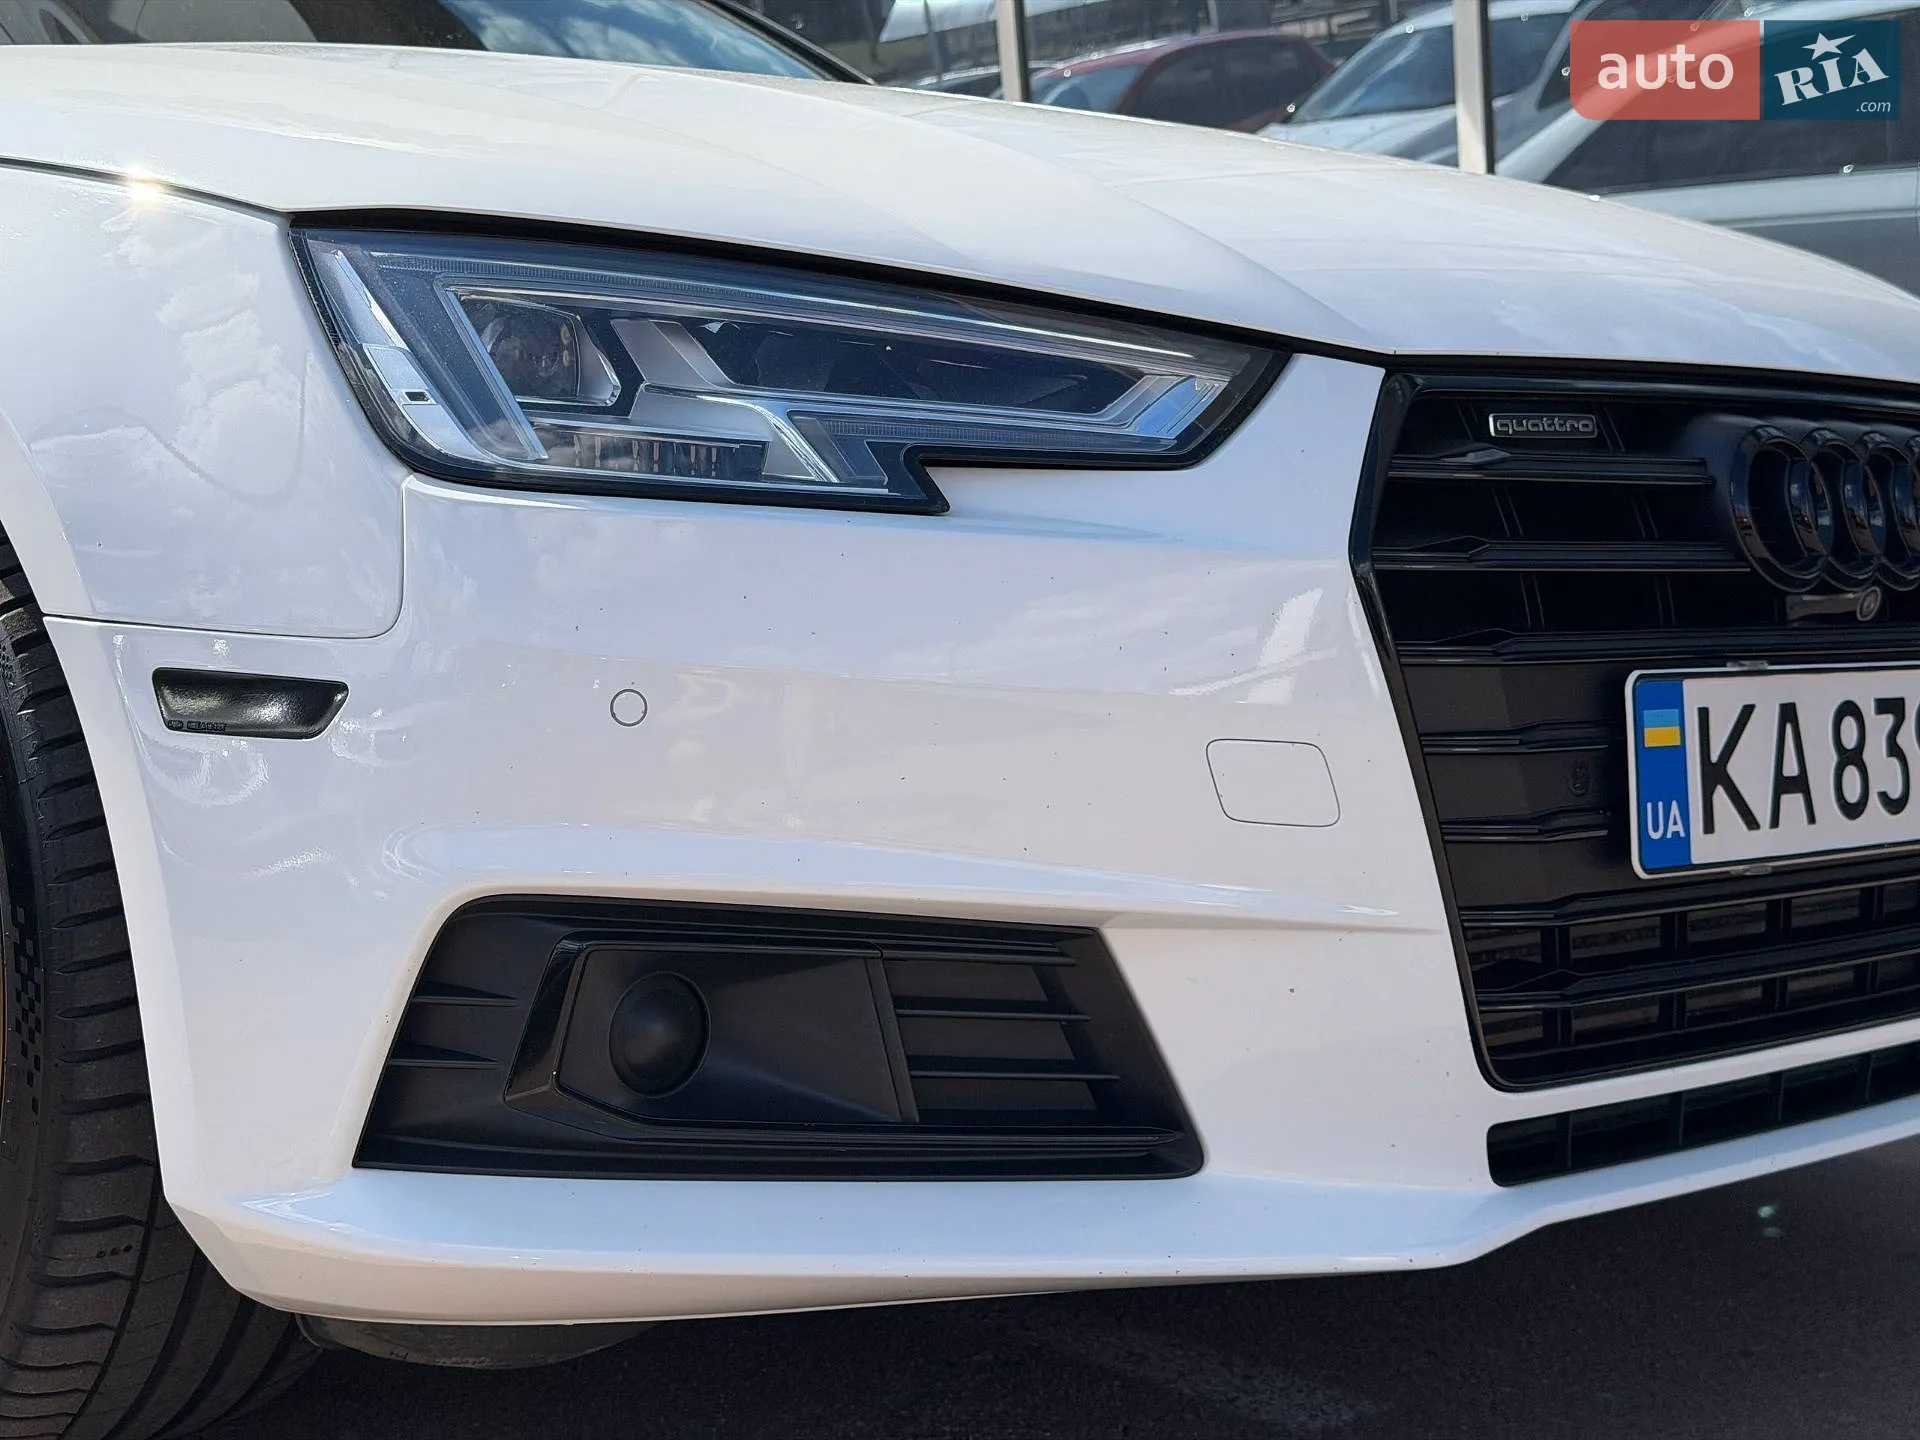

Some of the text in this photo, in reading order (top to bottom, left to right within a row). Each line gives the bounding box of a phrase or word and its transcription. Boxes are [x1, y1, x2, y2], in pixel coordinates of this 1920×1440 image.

[1496, 416, 1593, 435] quattro
[1831, 696, 1920, 821] 83
[1646, 800, 1686, 839] UA
